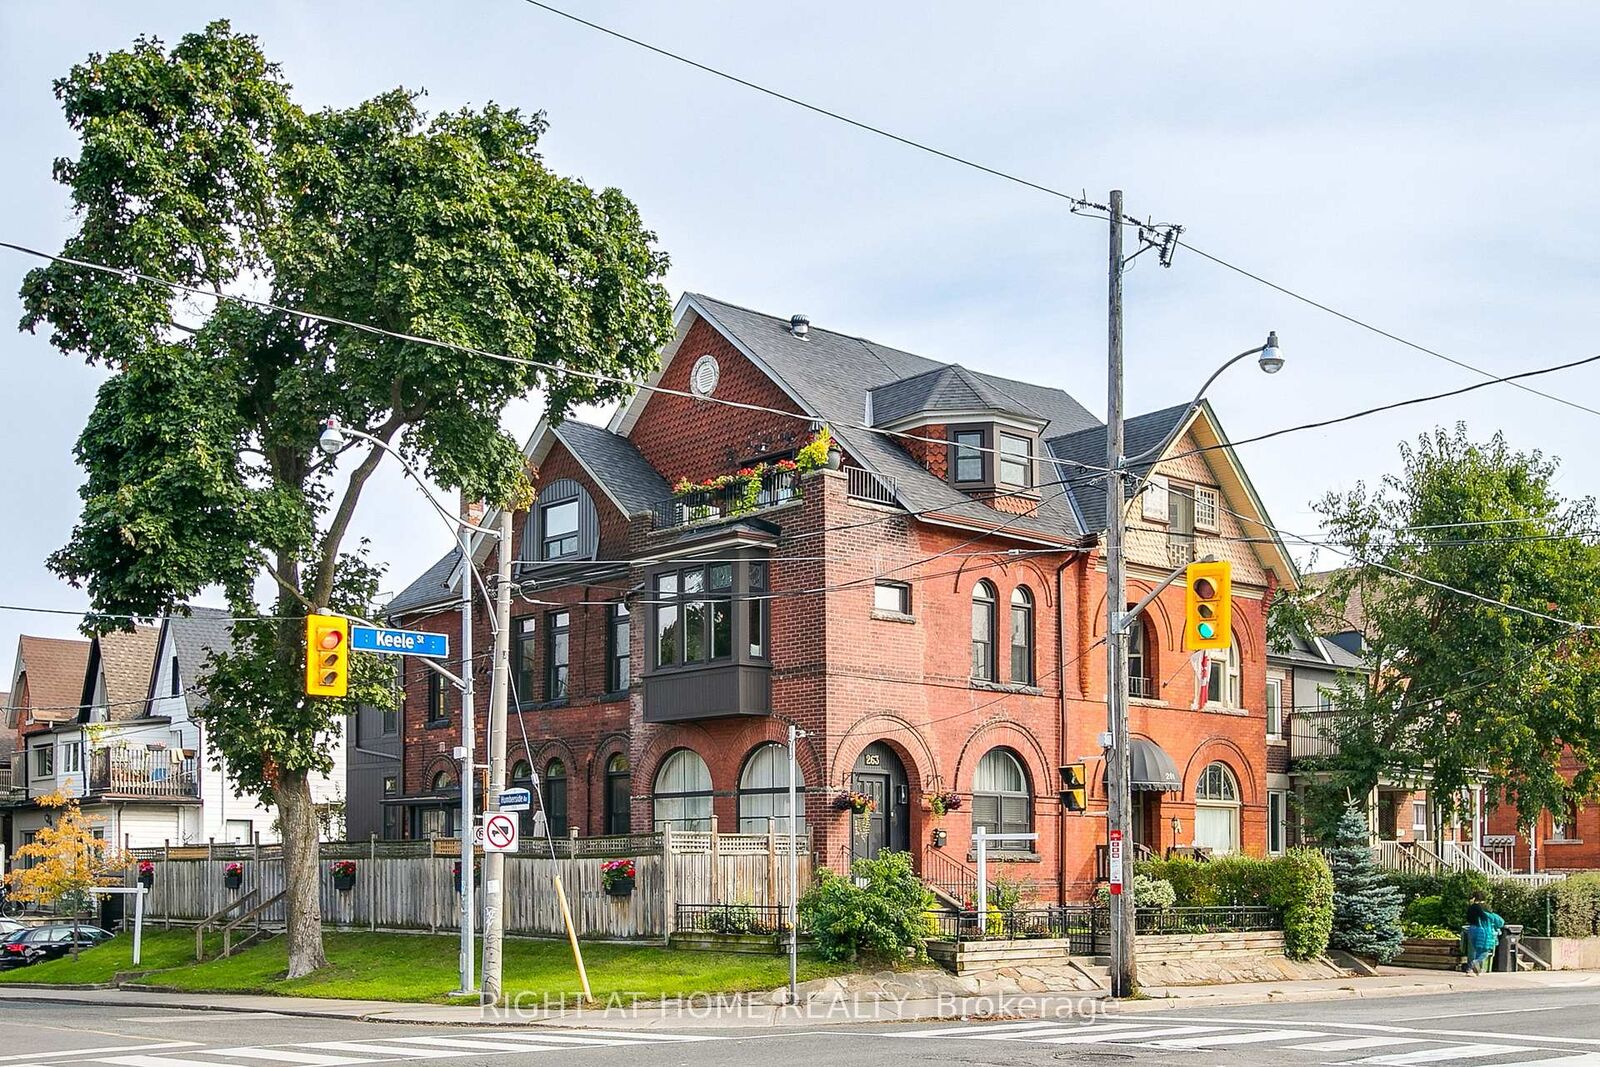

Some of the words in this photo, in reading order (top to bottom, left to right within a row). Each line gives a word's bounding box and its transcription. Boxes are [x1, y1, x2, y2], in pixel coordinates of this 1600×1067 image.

[376, 630, 415, 649] Keele
[416, 635, 424, 644] St
[865, 754, 880, 765] 263
